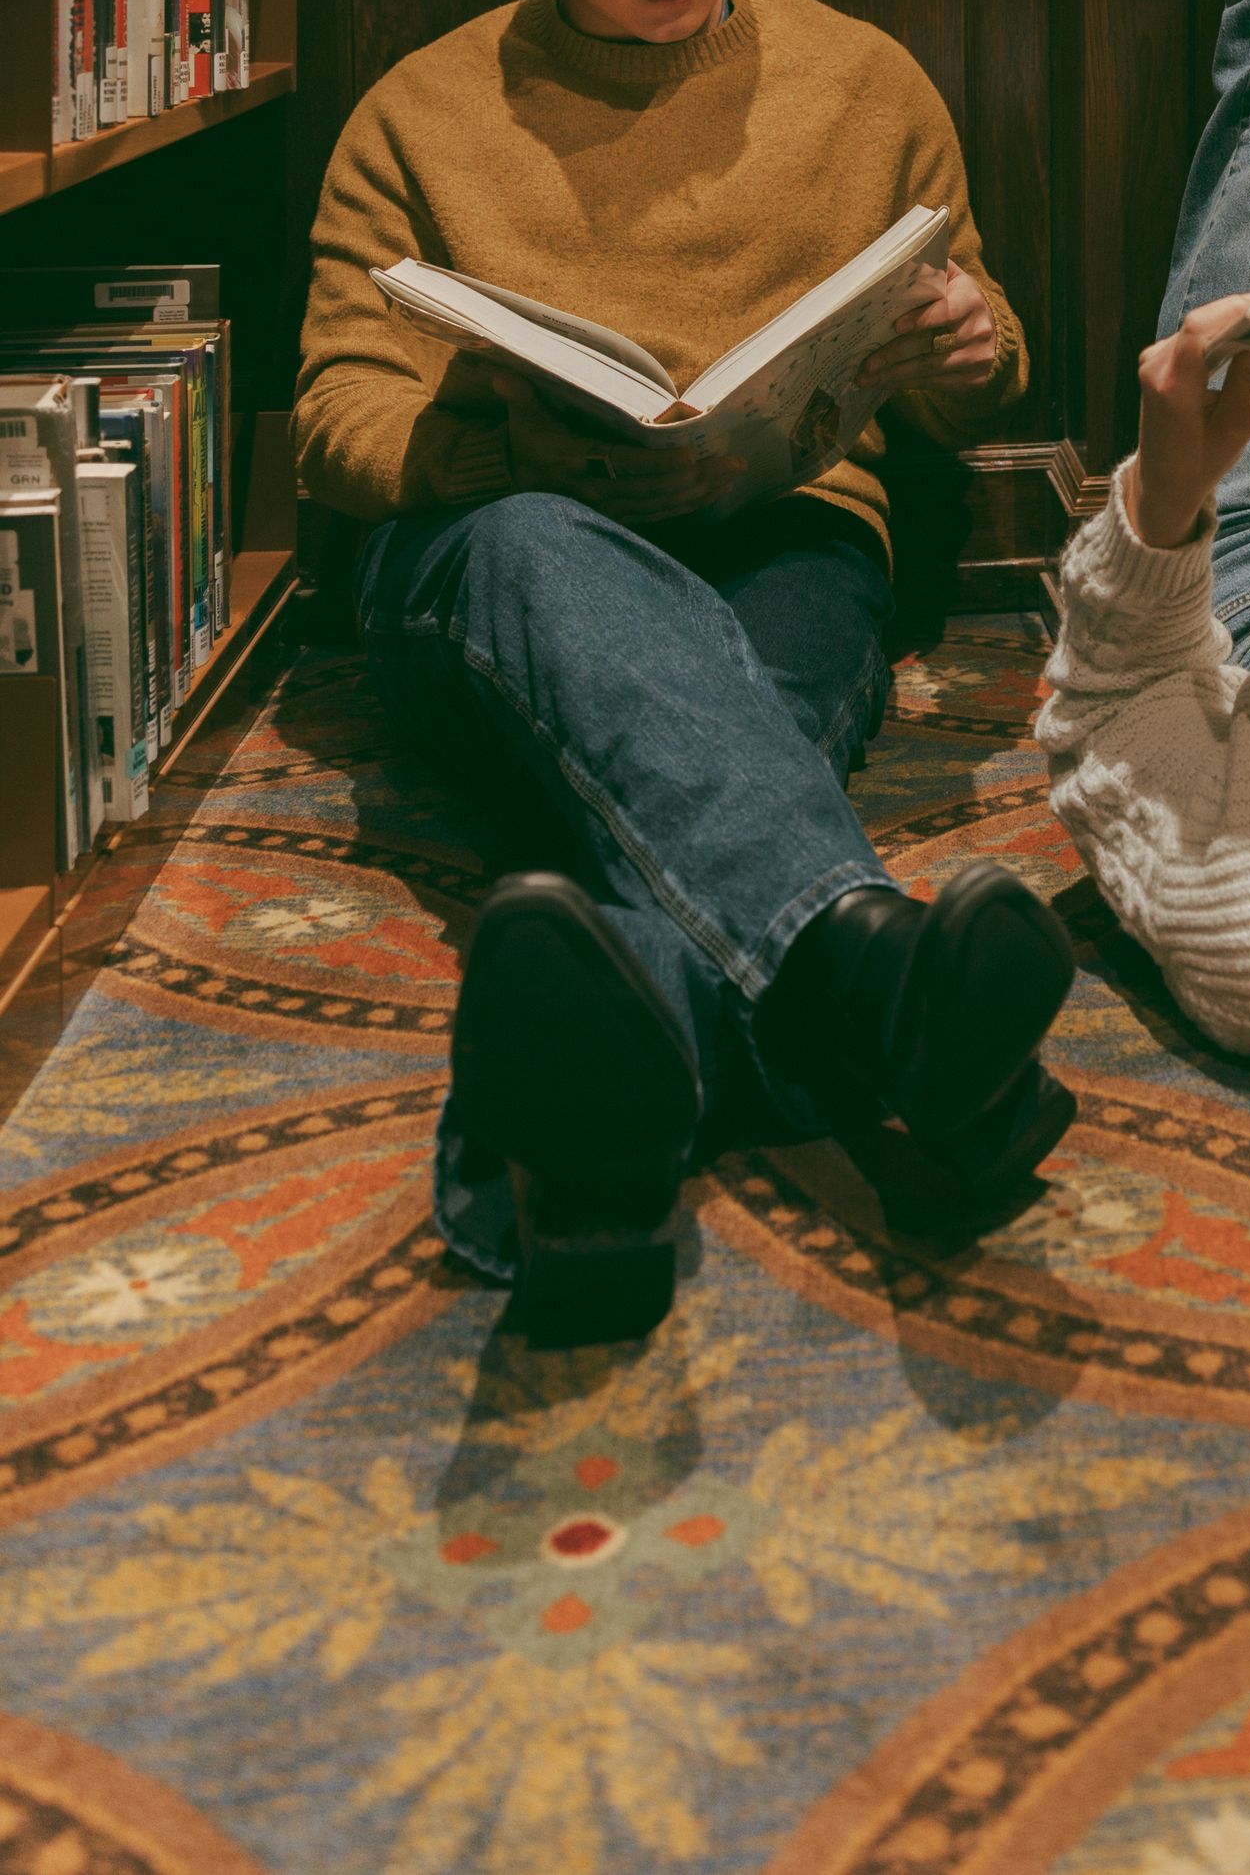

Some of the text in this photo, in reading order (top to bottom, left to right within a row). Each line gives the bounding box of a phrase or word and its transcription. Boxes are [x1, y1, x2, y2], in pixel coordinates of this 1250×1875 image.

[10, 474, 41, 486] GRN
[128, 531, 137, 571] THE
[129, 575, 141, 669] SPEAKING
